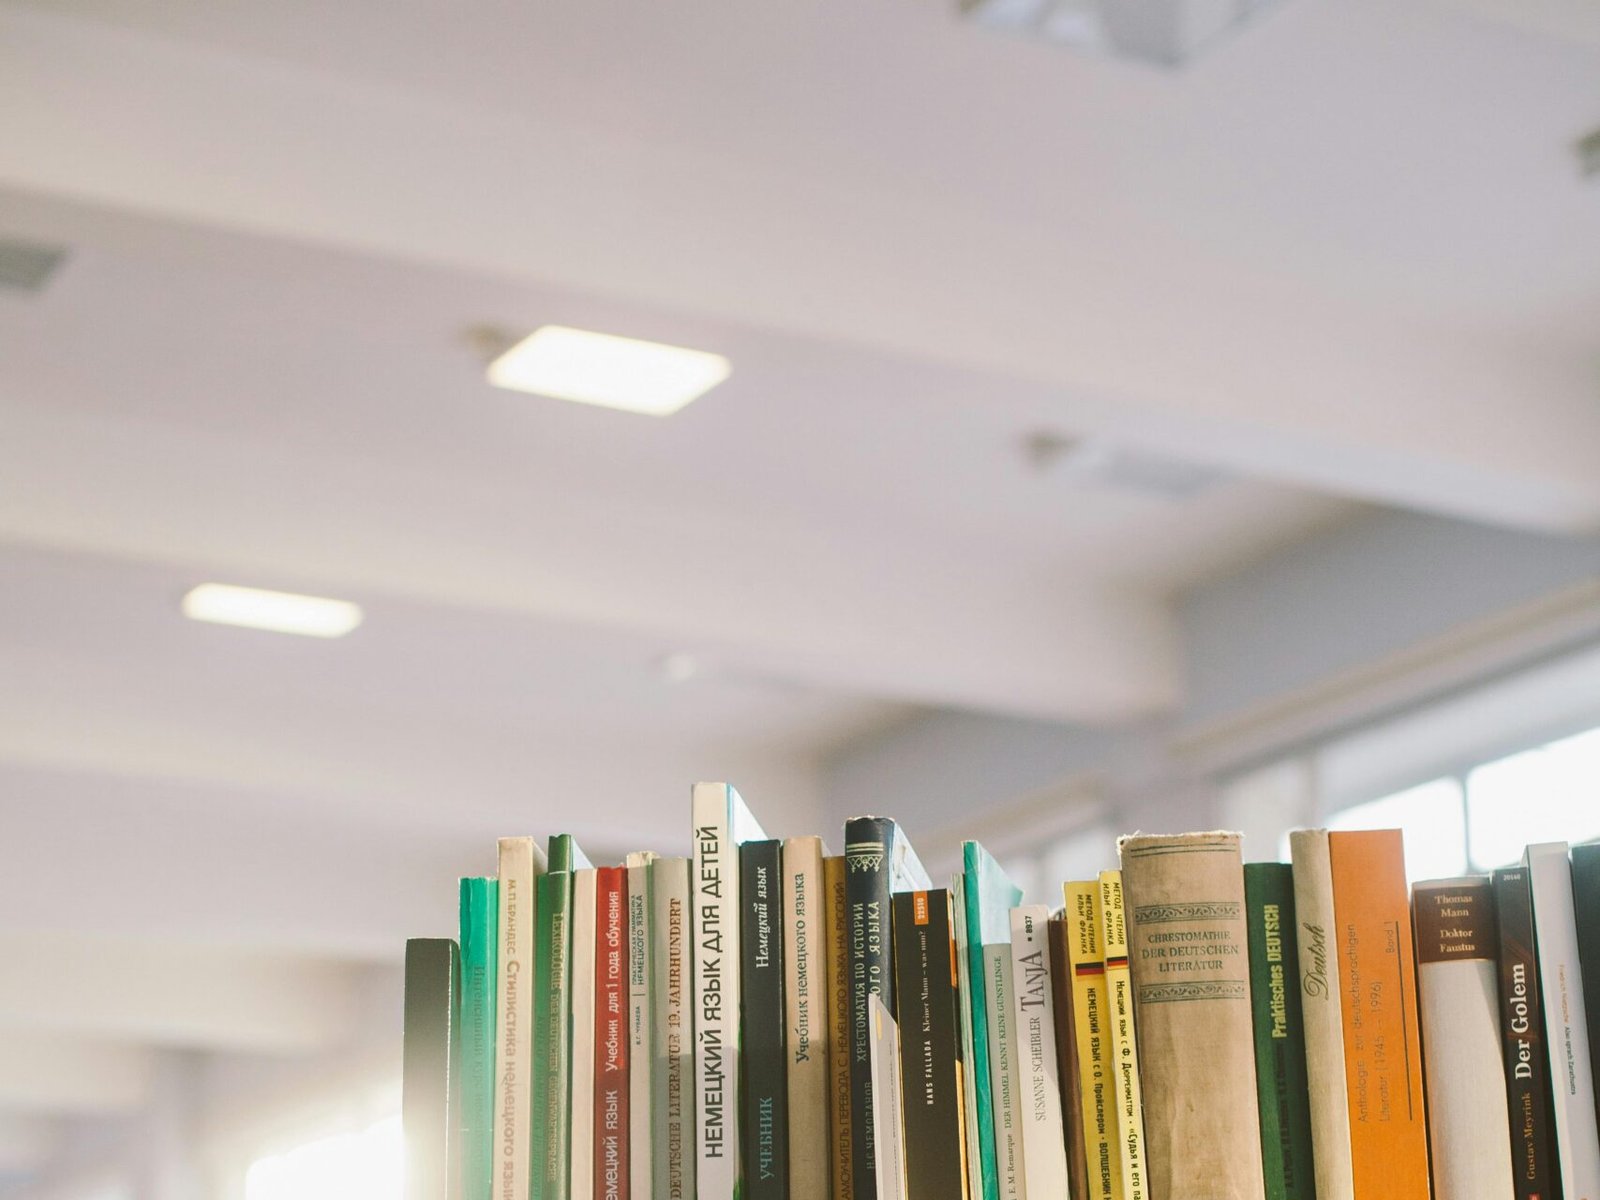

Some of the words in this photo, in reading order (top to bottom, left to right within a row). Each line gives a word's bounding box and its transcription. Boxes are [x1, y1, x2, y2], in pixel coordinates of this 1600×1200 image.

[696, 826, 722, 899] ДЕТЕЙ
[754, 866, 770, 900] язык
[793, 873, 806, 917] языка
[833, 882, 846, 931] РУССКИЙ
[1085, 894, 1095, 921] МЕТОД
[1113, 881, 1123, 910] МЕТОД
[1434, 893, 1473, 905] Thomas
[1441, 907, 1470, 919] Mann
[607, 891, 621, 948] обучения
[701, 905, 723, 954] ДЛЯ
[753, 903, 771, 968] Немецкий
[852, 903, 865, 959] ИСТОРИИ
[867, 900, 881, 956] ЯЗЫКА
[1078, 919, 1088, 955] ФРАНКА
[1087, 923, 1097, 955] ЧТЕНИЯ
[1105, 910, 1115, 946] ФРАНКА
[1115, 913, 1125, 945] ЧТЕНИЯ
[1147, 931, 1231, 944] CHRESTOMATHIE
[1263, 904, 1283, 962] DEUTSCH
[1440, 928, 1473, 940] Doktor
[607, 951, 620, 980] года
[668, 898, 682, 1008] JAHRHUNDERT
[794, 920, 811, 998] немецкого
[837, 953, 847, 986] ЯЗЫКА
[854, 963, 866, 979] ПО
[1142, 947, 1167, 960] DER
[1169, 944, 1239, 958] DEUTSCHEN
[1158, 959, 1224, 973] LITERATUR
[1302, 922, 1329, 1000] Deutsch
[1440, 941, 1475, 954] Faustus
[506, 960, 520, 1057] Стилистика
[607, 992, 620, 1014] для
[702, 960, 721, 1022] ЯЗЫК
[1018, 960, 1048, 1021] TANJA
[1269, 964, 1288, 1038] Praktisches
[1508, 963, 1529, 1034] Golem
[794, 1000, 811, 1064] Учебник
[837, 988, 849, 1054] НЕМЕЦКОГО
[854, 982, 868, 1063] ХРЕСТОМАТИЯ
[996, 1021, 1008, 1048] KEINE
[605, 1019, 621, 1073] Учебник
[998, 1050, 1010, 1080] KENNT
[1029, 1026, 1044, 1082] SCHEIBLER
[1513, 1039, 1533, 1080] Der
[668, 1033, 682, 1118] LITERATUR
[700, 1029, 725, 1159] НЕМЕЦКИЙ
[837, 1071, 850, 1125] ПЕРЕВОДА
[1000, 1081, 1012, 1118] HIMMEL
[501, 1061, 517, 1156] немецкого
[604, 1090, 619, 1130] язык
[1003, 1119, 1013, 1138] DER
[1032, 1084, 1047, 1130] SUSANNE
[1520, 1092, 1535, 1140] Meyrink
[669, 1122, 682, 1200] DEUTSCHE
[759, 1097, 775, 1181] УЧЕБНИК
[1005, 1142, 1017, 1182] Remarque
[1524, 1142, 1537, 1181] Gustav
[1099, 1142, 1112, 1195] ВОЛШЕБНИК
